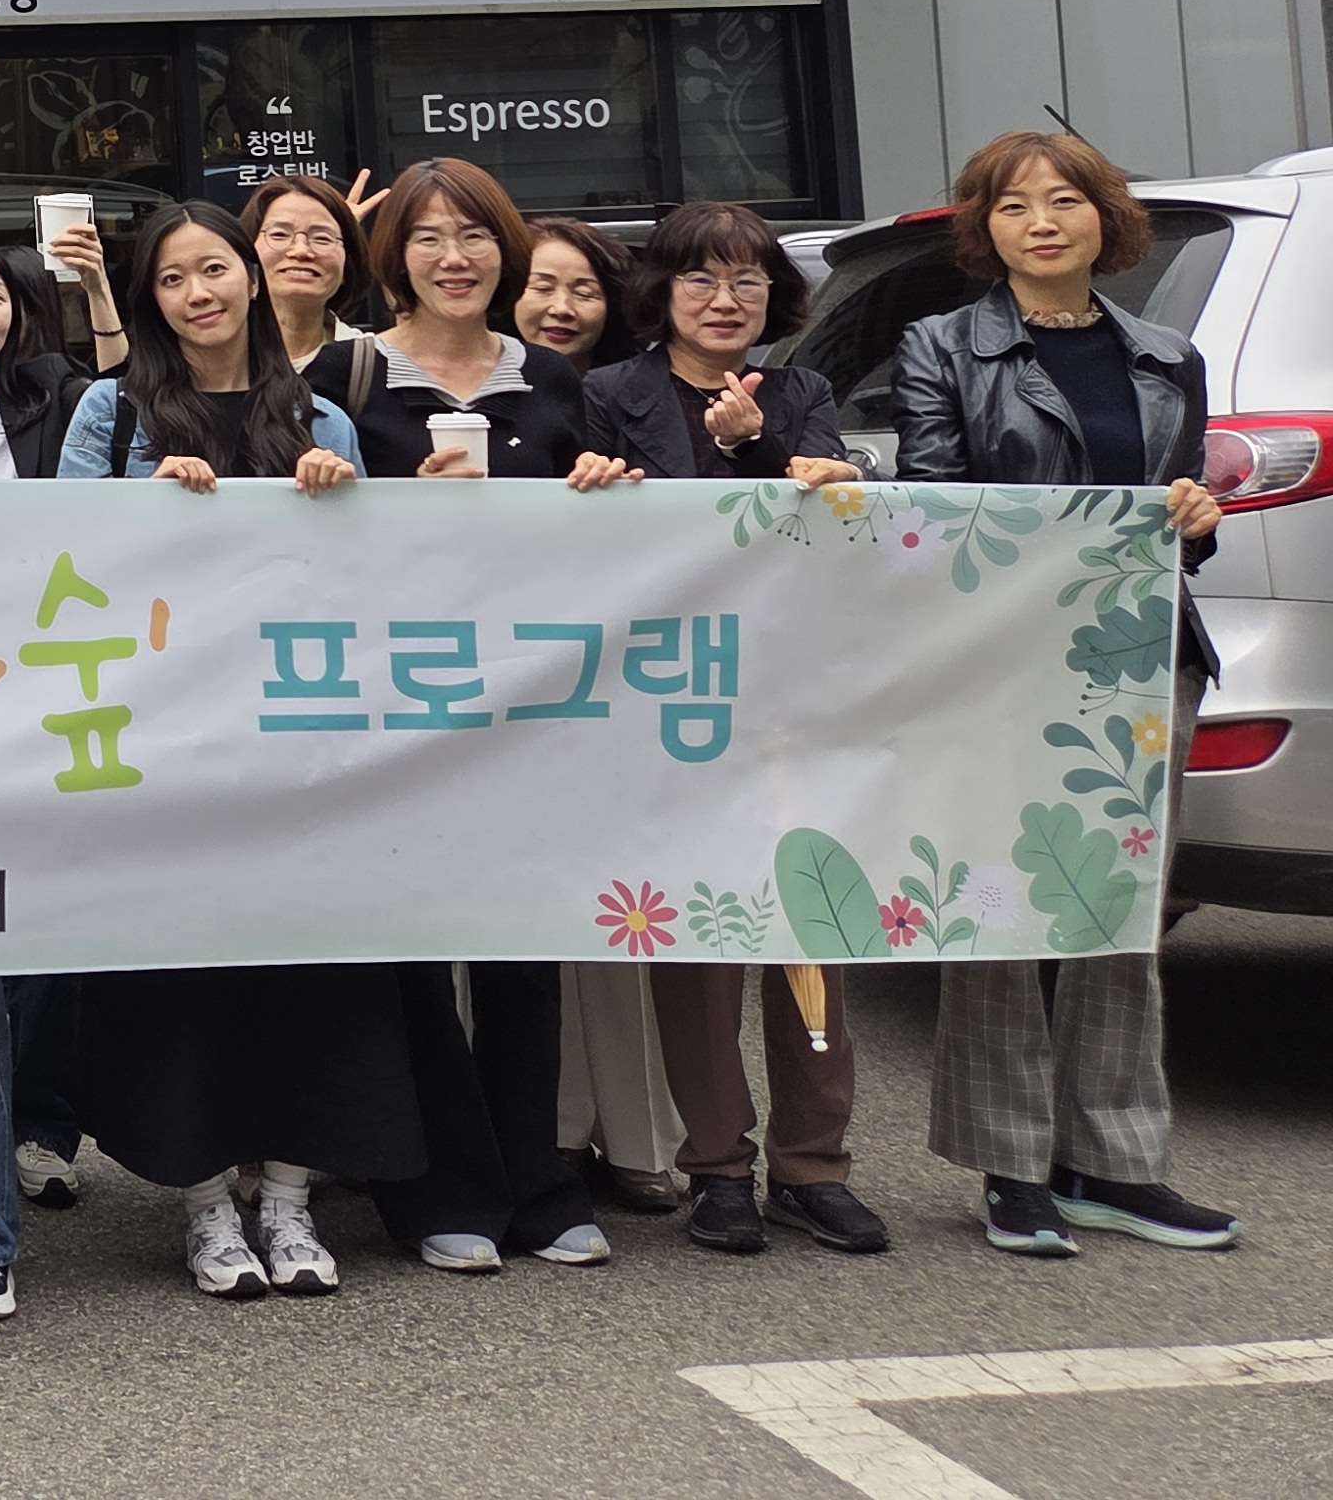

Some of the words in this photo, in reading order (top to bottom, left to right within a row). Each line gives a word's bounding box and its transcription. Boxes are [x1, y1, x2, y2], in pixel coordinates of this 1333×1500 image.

[422, 94, 610, 142] Espresso
[246, 129, 317, 157] 창업반
[259, 614, 739, 763] 프로그램
